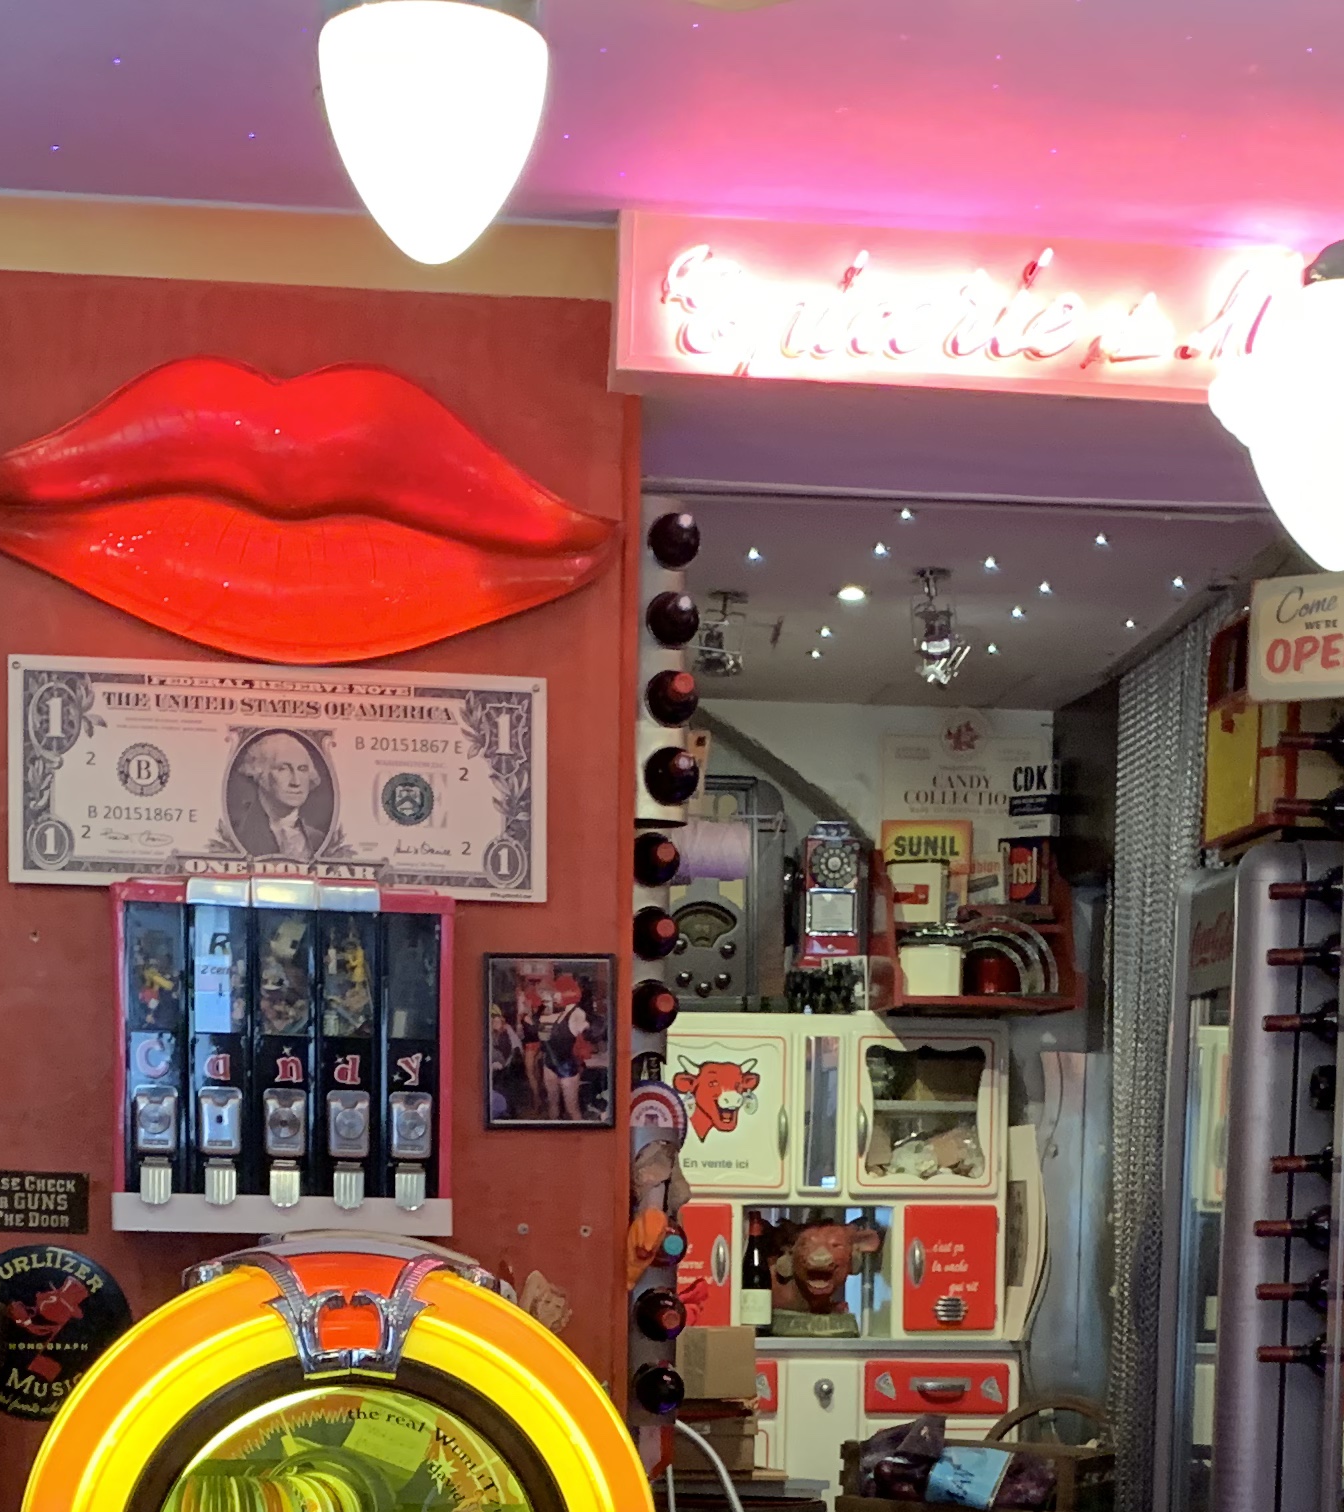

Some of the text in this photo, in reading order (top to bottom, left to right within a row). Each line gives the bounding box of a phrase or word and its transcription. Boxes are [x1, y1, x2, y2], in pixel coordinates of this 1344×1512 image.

[1276, 586, 1339, 624] Come
[149, 675, 412, 698] FEDERAL RESERVE NOTE
[45, 697, 67, 738] 1
[103, 692, 458, 725] THE UNITED STATES OF AMERICA
[495, 713, 514, 756] 1
[356, 737, 365, 750] B
[370, 737, 448, 754] 20151867
[86, 752, 96, 765] 2
[135, 759, 153, 781] B
[459, 768, 469, 781] 2
[1013, 765, 1049, 793] CDK
[932, 774, 992, 789] CANDY
[903, 789, 1008, 806] COLLECTIO
[87, 806, 198, 823] B 20151867 E
[43, 827, 58, 855] 1
[81, 825, 92, 839] 2
[462, 841, 472, 855] 2
[894, 836, 960, 857] SUNIL
[185, 859, 249, 875] ONE
[253, 861, 377, 880] DOLLAR
[498, 848, 511, 875] 1
[683, 1158, 749, 1170] En vente ici
[24, 1174, 76, 1193] CHECK
[14, 1192, 68, 1211] GUNS
[27, 1210, 70, 1228] DOOR
[347, 1408, 380, 1422] the
[386, 1413, 426, 1433] real
